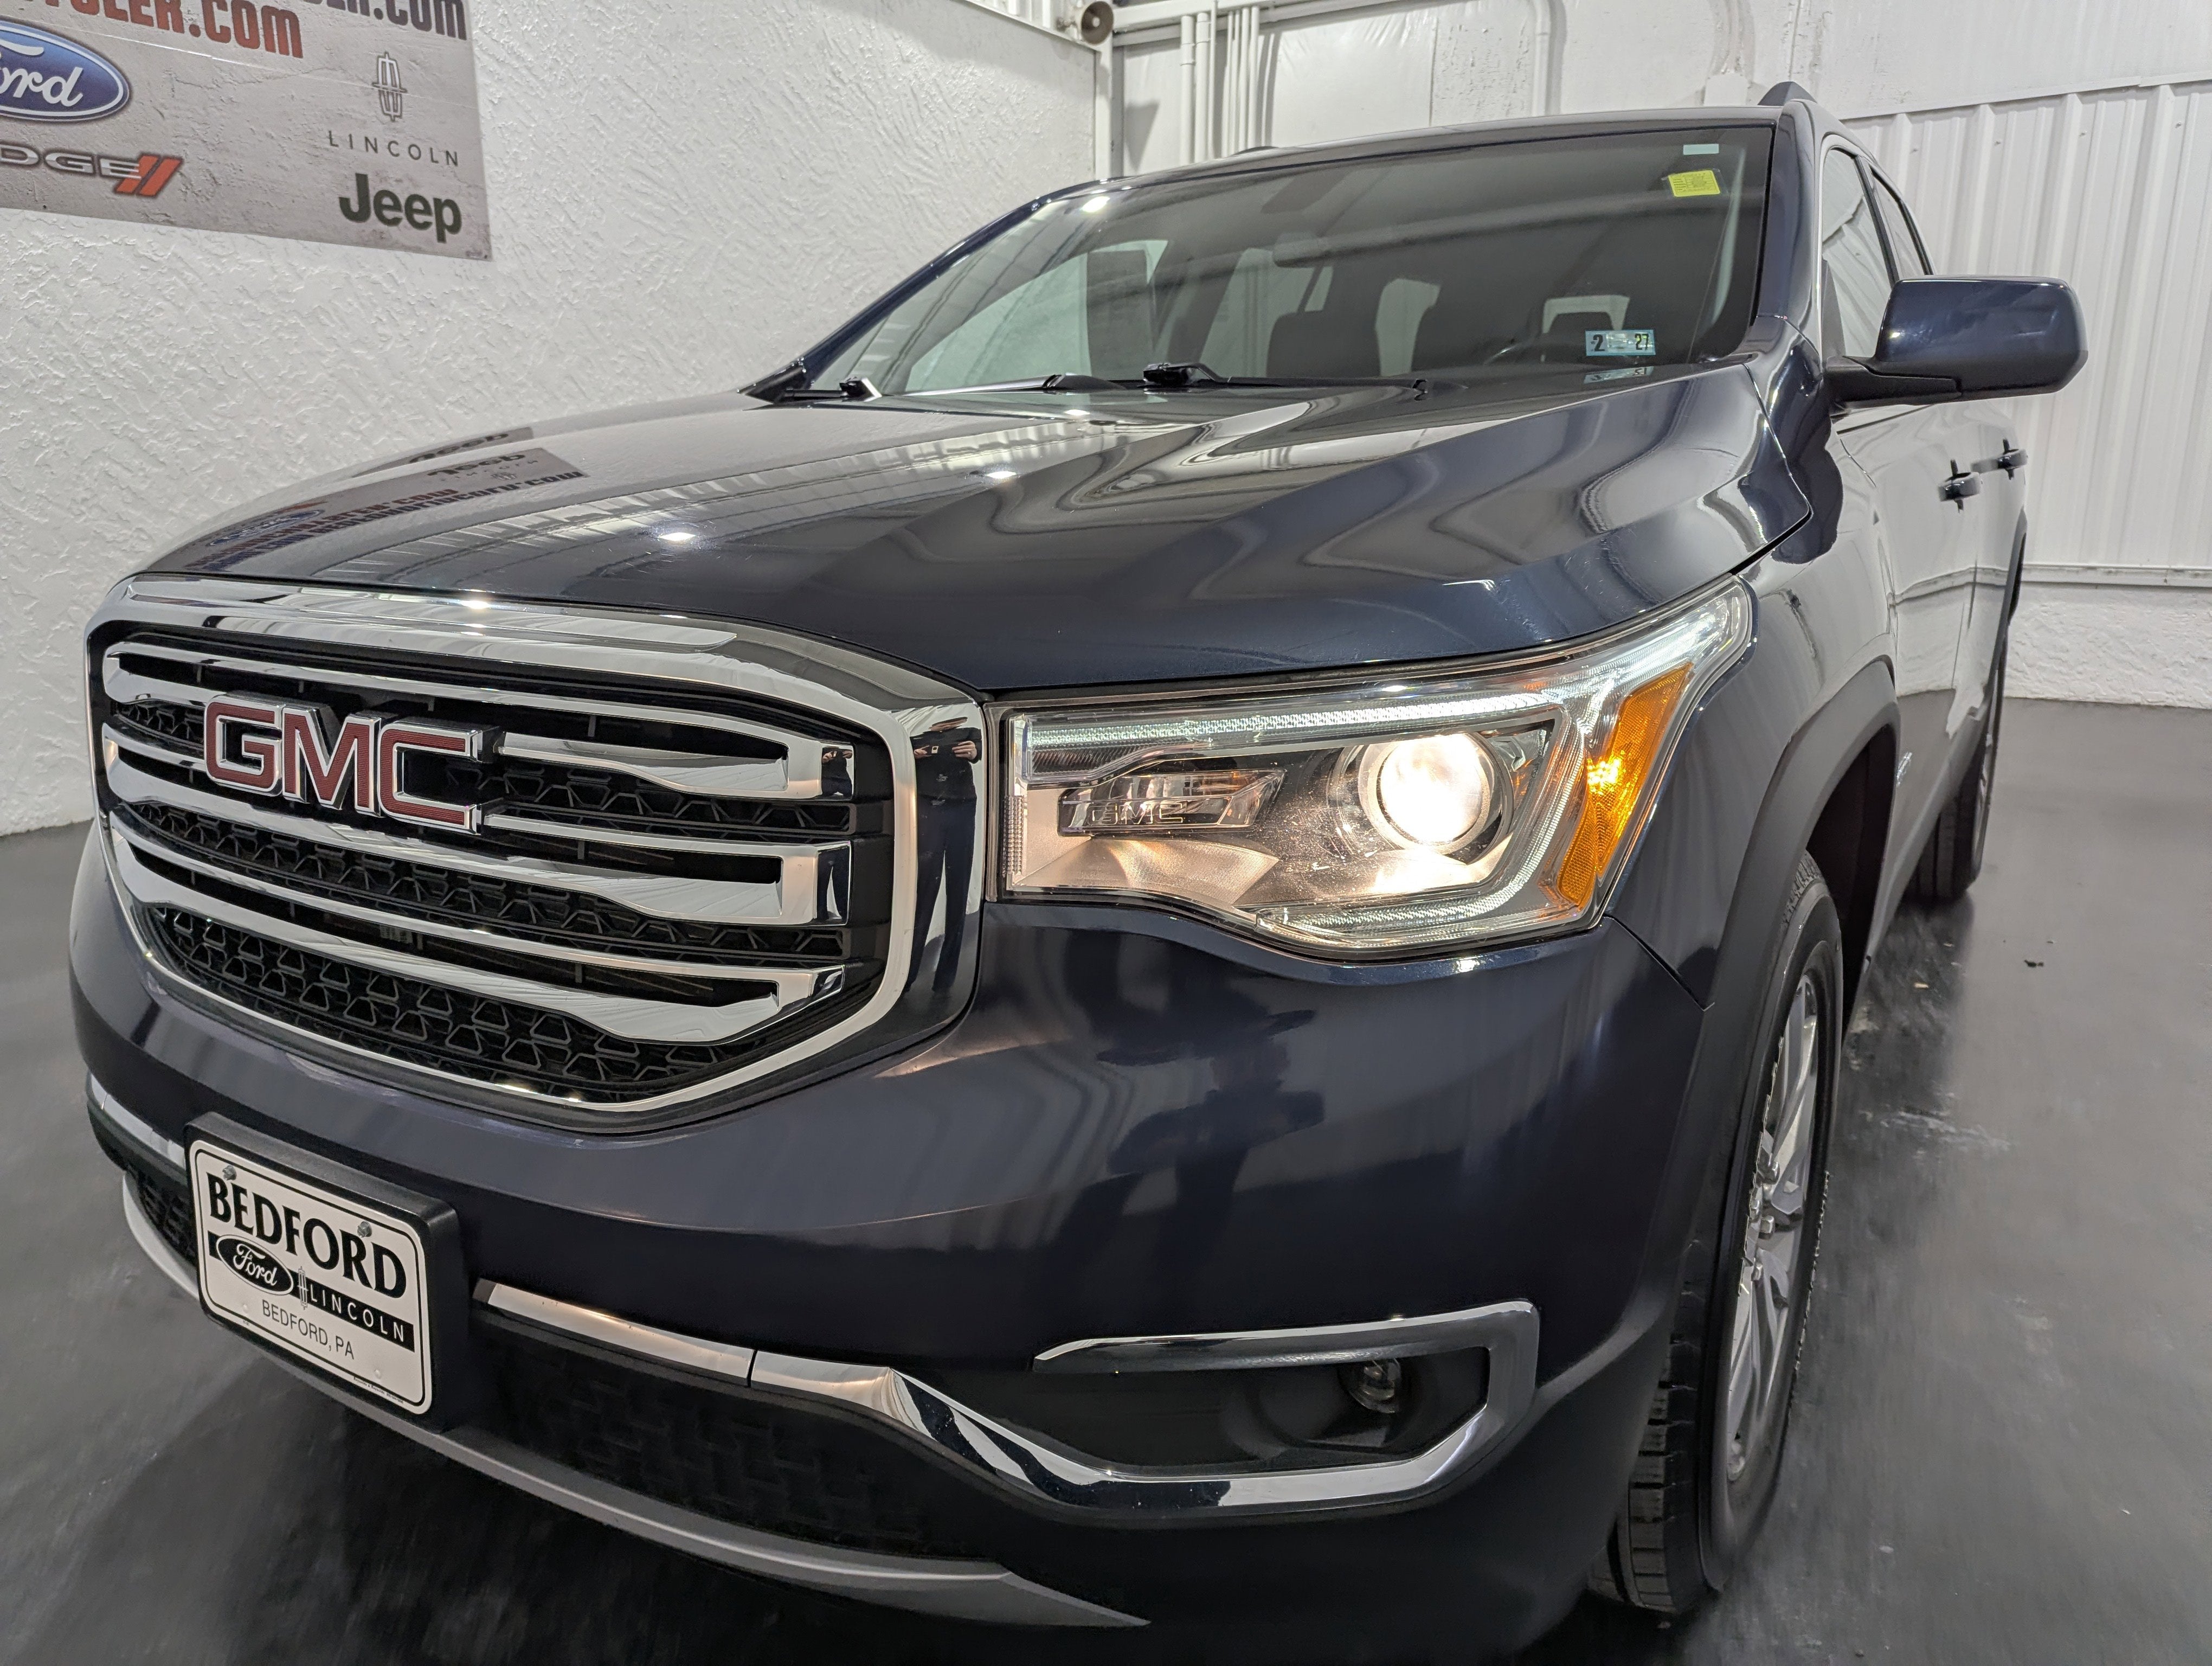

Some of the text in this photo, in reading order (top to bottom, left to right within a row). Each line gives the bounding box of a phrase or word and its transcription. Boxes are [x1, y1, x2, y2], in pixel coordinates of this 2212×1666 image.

[46, 0, 304, 59] ER.COM
[328, 130, 460, 168] LINCOLN
[338, 172, 463, 245] Jeep
[1593, 333, 1649, 352] 2 27
[204, 693, 481, 835] GMC
[1087, 803, 1184, 825] GMC
[205, 1171, 407, 1299] BEDFORD
[233, 1243, 278, 1286] Ford
[262, 1299, 355, 1360] BEDFORD, PA
[310, 1284, 404, 1342] LINCOLN
